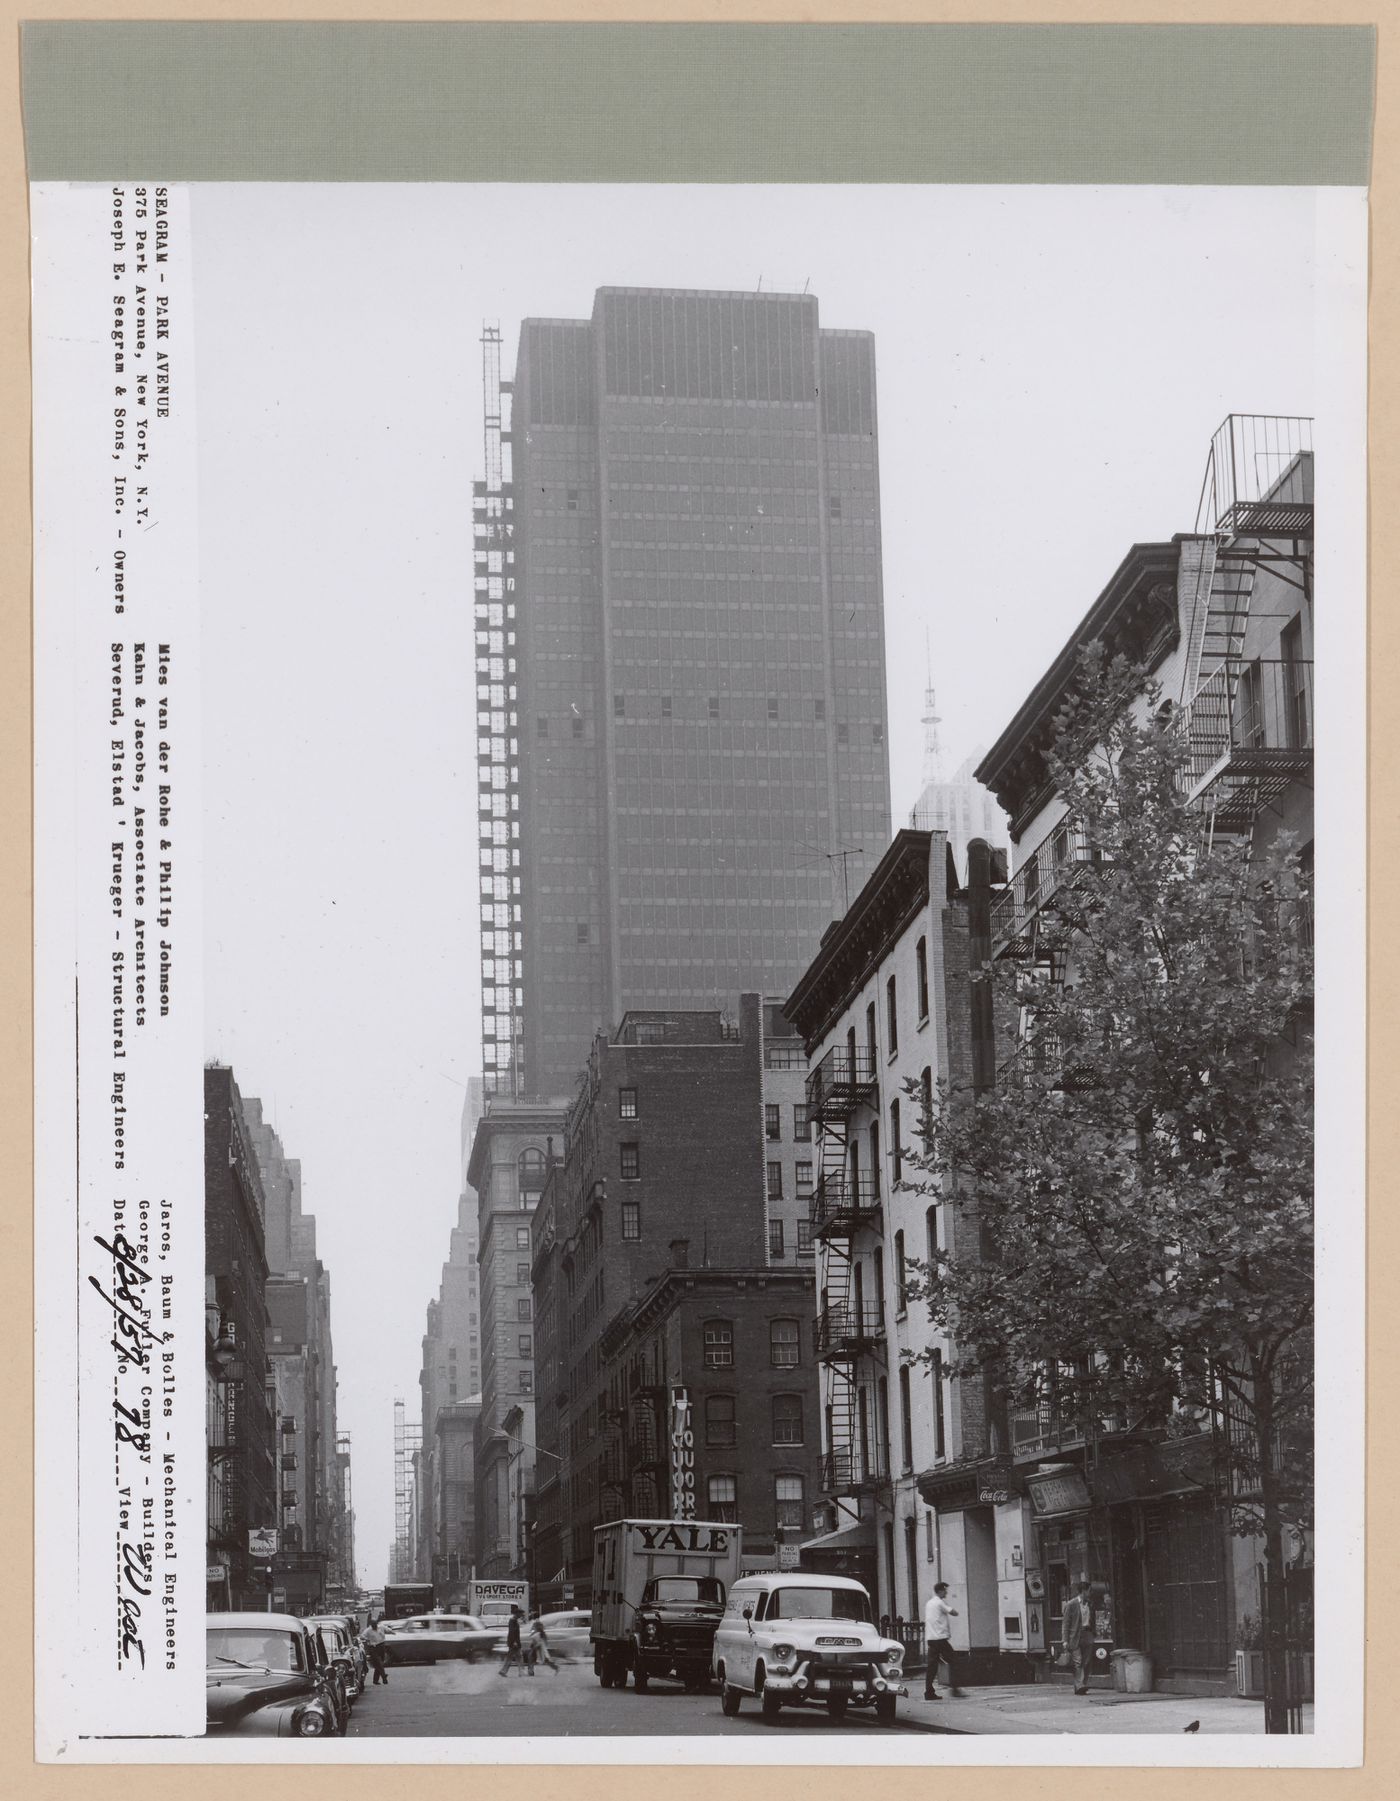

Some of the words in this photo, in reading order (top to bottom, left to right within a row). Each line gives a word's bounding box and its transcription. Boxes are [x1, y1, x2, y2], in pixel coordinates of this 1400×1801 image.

[110, 187, 126, 252] Joseph
[135, 187, 148, 219] 375
[155, 187, 169, 263] SEAGRAM
[113, 263, 126, 281] E.
[135, 230, 148, 274] Park
[110, 295, 126, 373] Seagram
[133, 285, 147, 359] Avenue,
[156, 295, 169, 340] PARK
[136, 374, 148, 406] New
[156, 351, 170, 418] AVENUE
[111, 408, 127, 460] Sons,
[134, 418, 149, 471] York,
[114, 476, 127, 515] Inc.
[136, 486, 149, 526] N.Y.
[113, 550, 127, 614] Owners
[109, 642, 125, 726] Severud,
[133, 642, 146, 686] Kahn
[158, 643, 171, 686] Mies
[158, 697, 168, 730] van
[111, 739, 125, 807] Elstad
[132, 718, 146, 792] Jacobs,
[158, 741, 171, 774] der
[158, 784, 171, 827] Rohe
[109, 841, 124, 918] Krueger
[134, 806, 146, 906] Associate
[156, 861, 172, 928] Philip
[134, 918, 147, 1027] Architects
[159, 940, 172, 1017] Johnson
[111, 951, 126, 1059] Structural
[110, 1071, 127, 1170] Engineers
[113, 1199, 126, 1241] Dat
[137, 1200, 150, 1264] George
[158, 1199, 173, 1261] Jaros,
[160, 1274, 174, 1320] Baum
[117, 1354, 130, 1375] No
[140, 1309, 152, 1375] Fuller
[162, 1352, 175, 1417] Bolles
[139, 1386, 152, 1464] Company
[119, 1486, 132, 1531] View
[163, 1453, 178, 1561] Mechanical
[636, 1524, 728, 1552] YALE
[142, 1497, 155, 1583] Builders
[250, 1546, 276, 1554] Mobilgas
[161, 1573, 178, 1670] Engineers
[475, 1584, 525, 1596] DAVEGA
